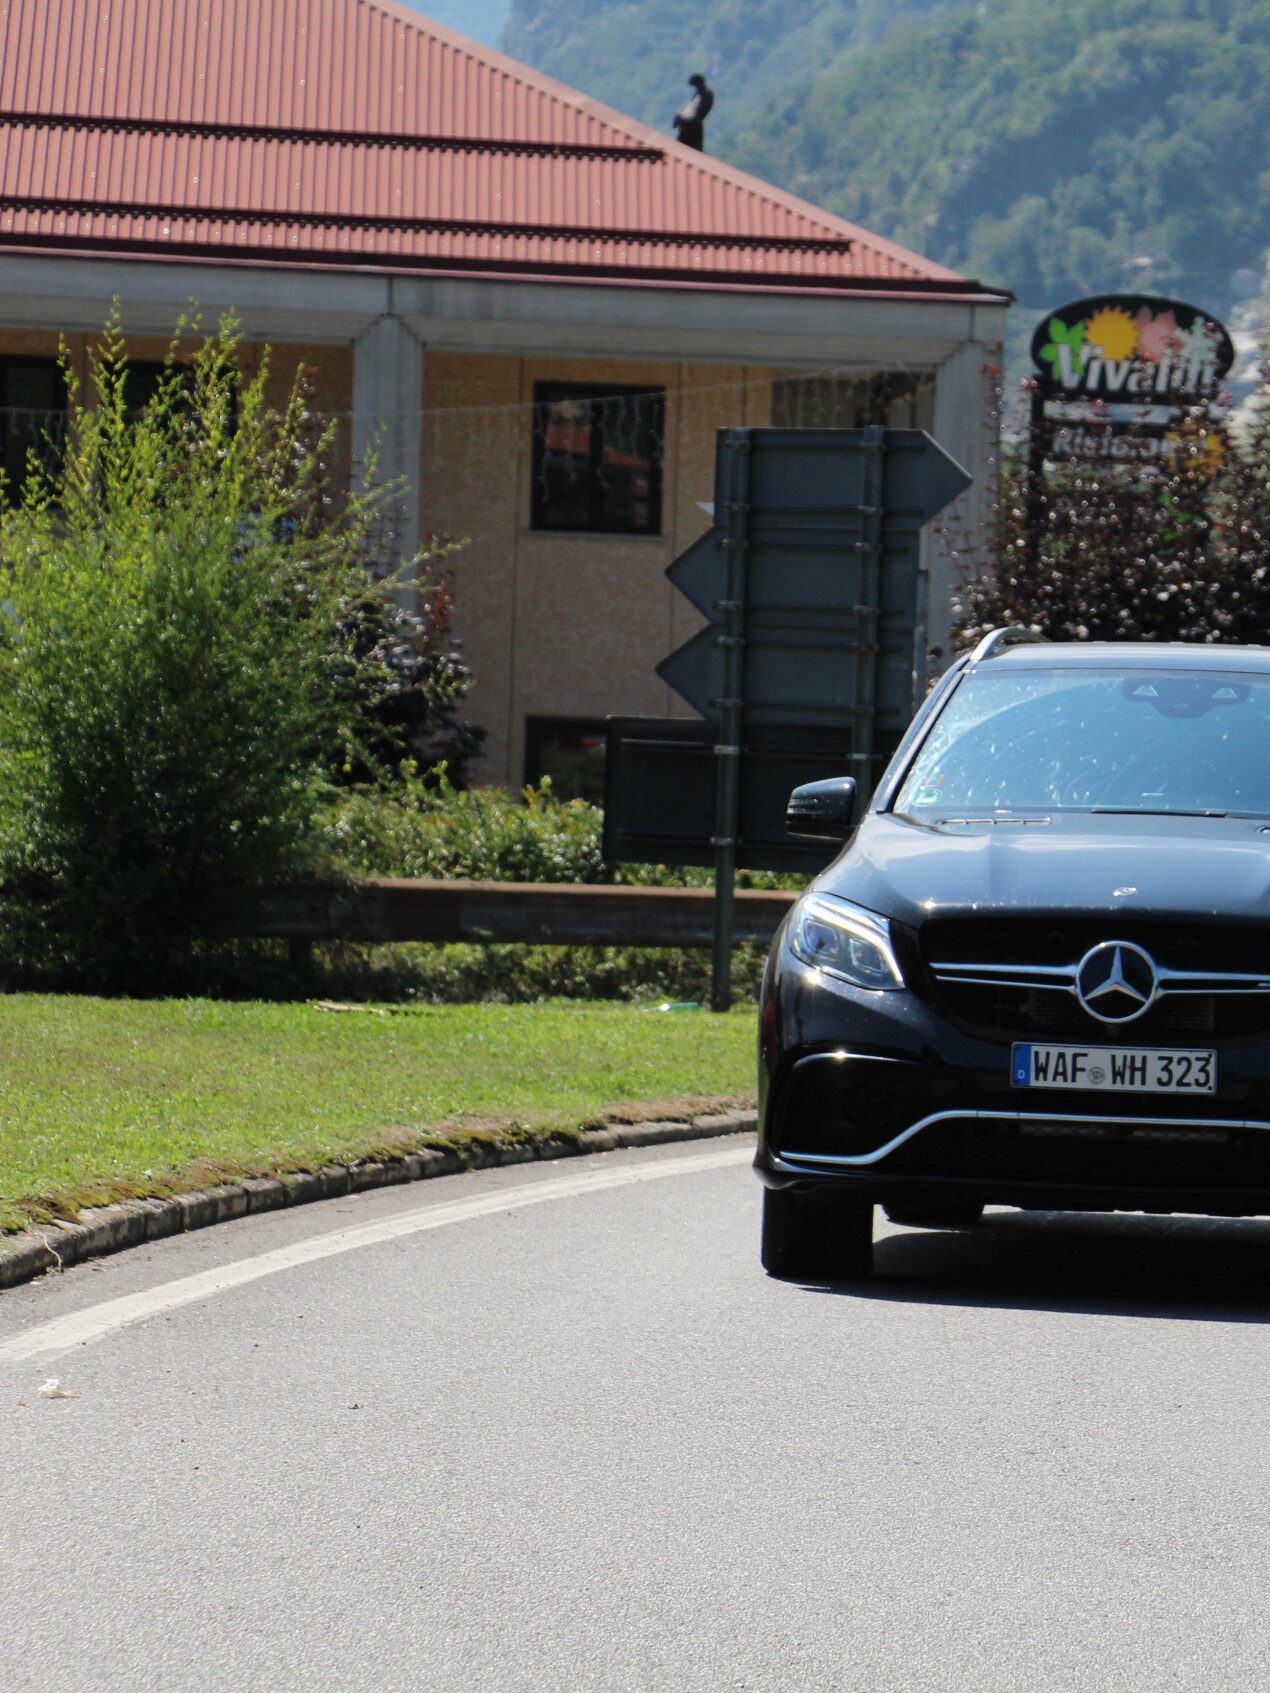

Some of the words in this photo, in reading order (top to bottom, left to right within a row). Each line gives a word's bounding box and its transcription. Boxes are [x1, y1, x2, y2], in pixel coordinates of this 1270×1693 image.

[1017, 1069, 1025, 1080] D
[1033, 1050, 1089, 1084] WAF
[1111, 1054, 1148, 1087] WH
[1156, 1055, 1212, 1088] 323
